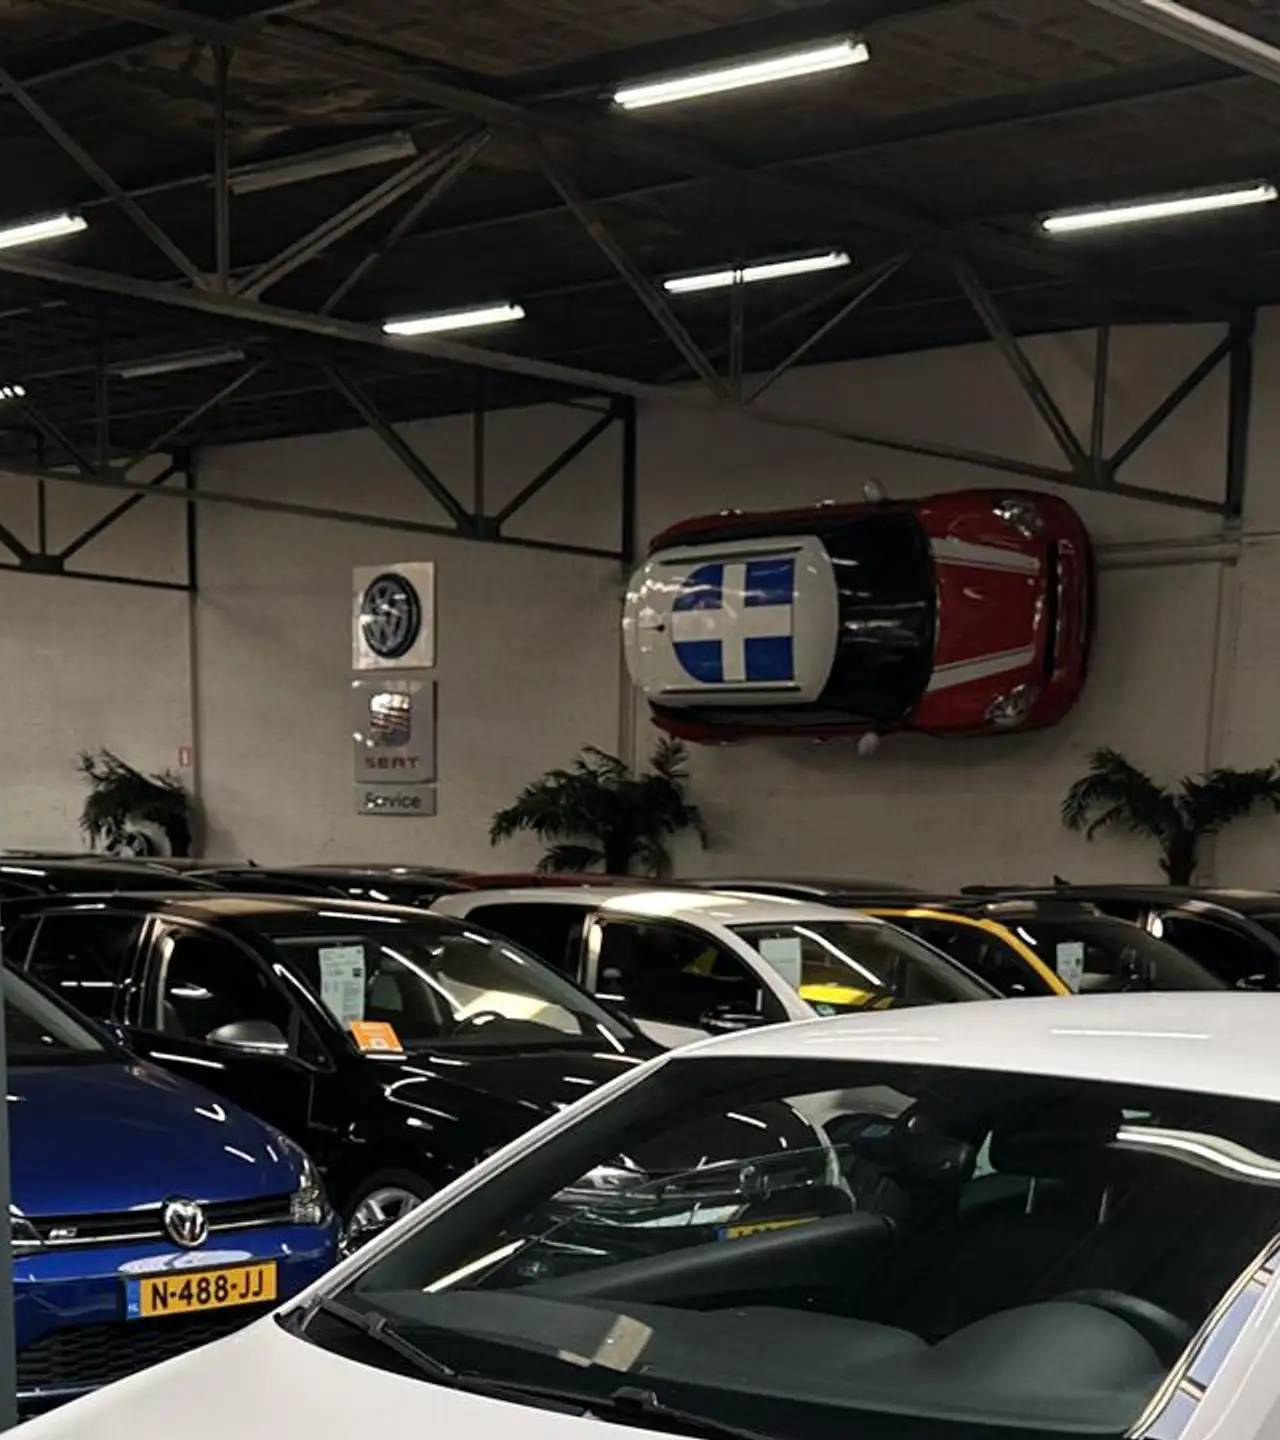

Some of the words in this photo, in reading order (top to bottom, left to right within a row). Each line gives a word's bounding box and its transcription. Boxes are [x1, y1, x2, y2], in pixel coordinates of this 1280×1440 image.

[364, 755, 420, 770] SEAT
[363, 791, 422, 810] Service
[151, 1269, 265, 1311] N-488-JJ
